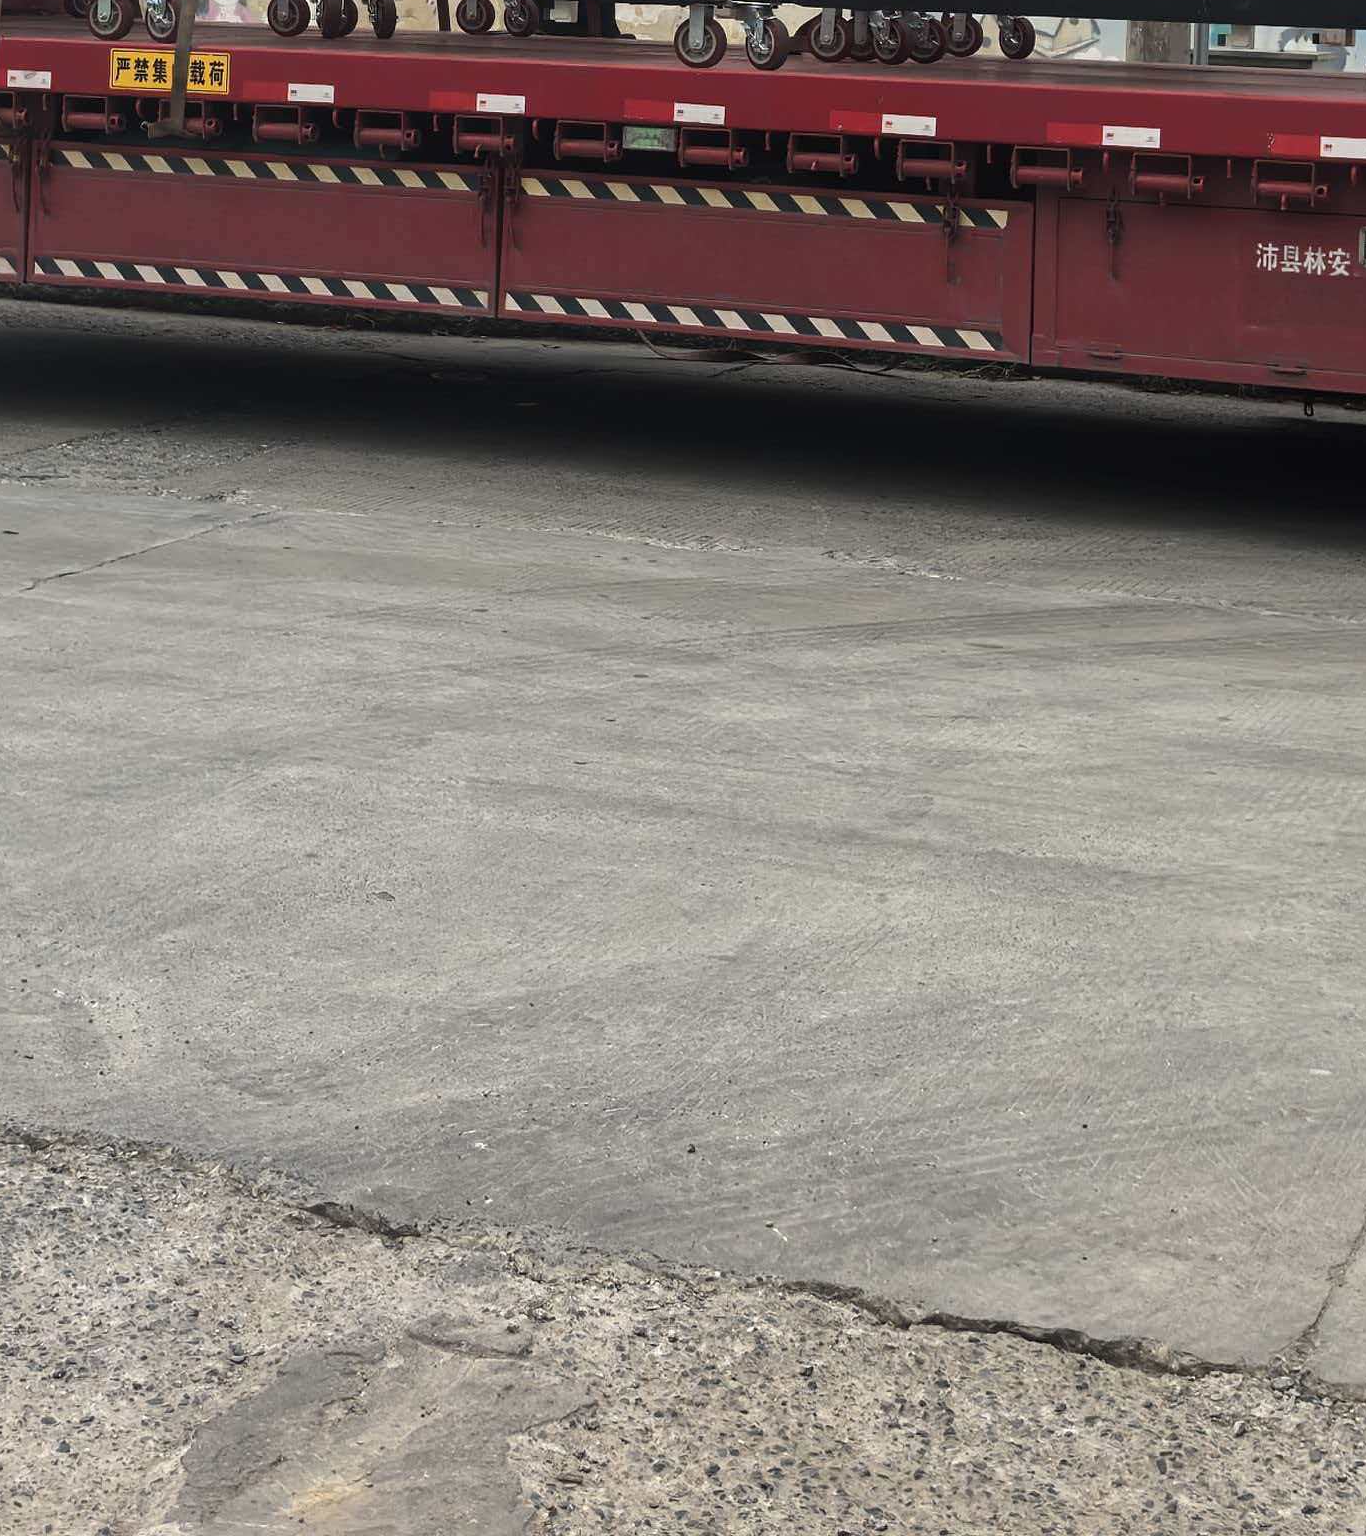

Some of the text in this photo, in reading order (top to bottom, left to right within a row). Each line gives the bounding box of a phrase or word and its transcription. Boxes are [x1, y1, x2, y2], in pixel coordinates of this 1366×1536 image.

[115, 56, 225, 86] 严禁集载荷
[1255, 242, 1351, 277] 沛县林安
